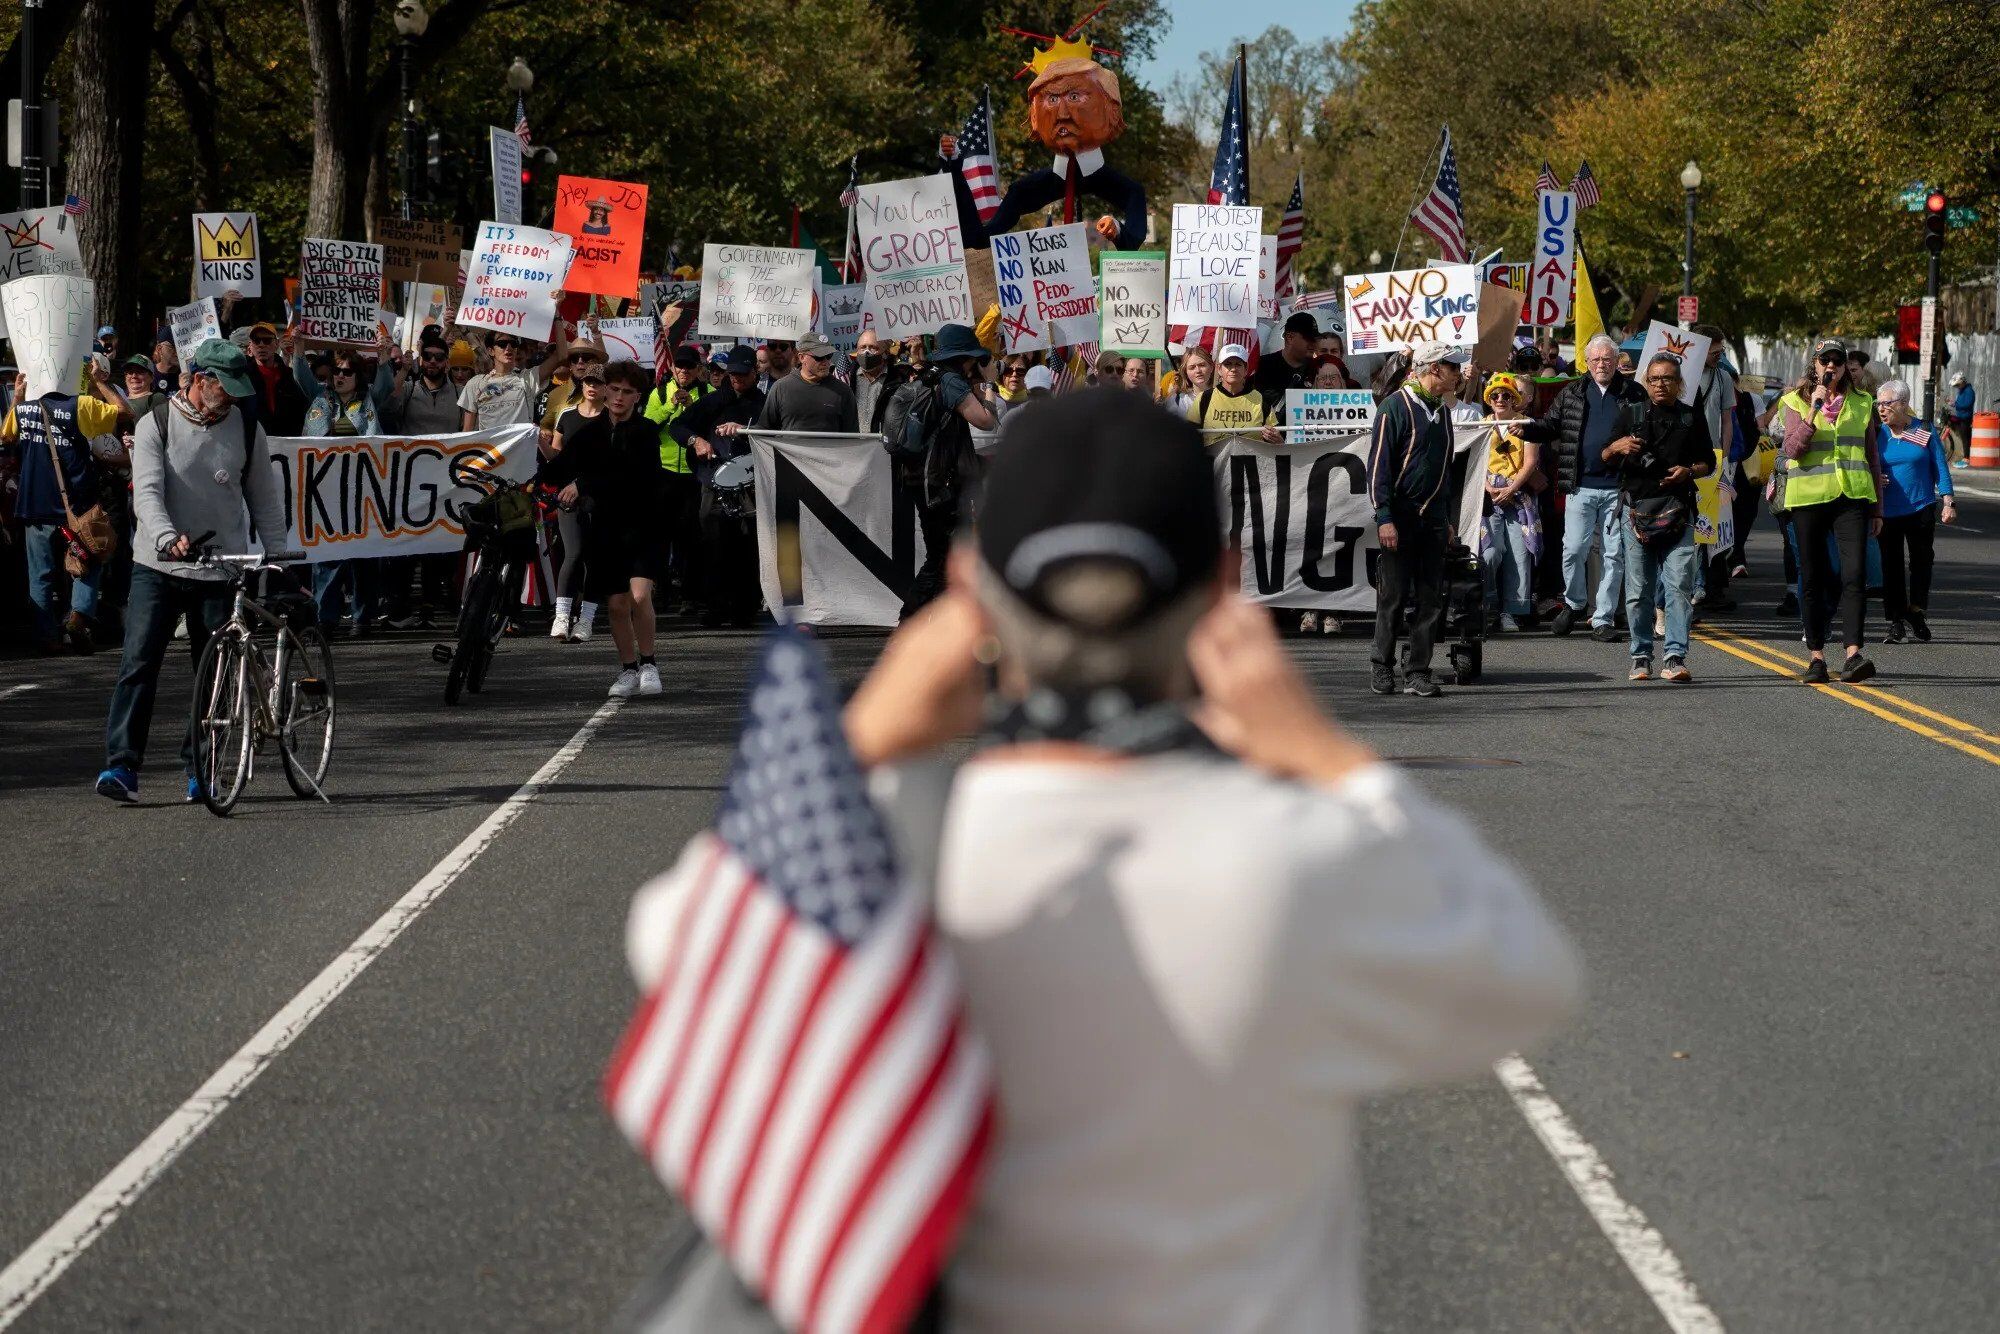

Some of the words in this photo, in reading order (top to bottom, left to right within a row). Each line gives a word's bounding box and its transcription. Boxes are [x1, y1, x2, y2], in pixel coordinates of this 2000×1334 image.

[559, 184, 589, 208] Hey
[610, 185, 643, 211] JD
[861, 195, 908, 227] You
[1173, 205, 1188, 230] I
[1198, 206, 1262, 228] PROTEST
[485, 226, 515, 240] IT'S
[217, 241, 241, 257] NO
[867, 226, 965, 272] GROPE
[995, 235, 1021, 258] NO
[1177, 231, 1257, 254] BECAUSE
[37, 252, 61, 264] THE
[414, 249, 438, 261] HIM
[445, 251, 460, 262] TO
[481, 254, 500, 264] FOR
[492, 244, 549, 260] FREEDOM
[574, 246, 621, 264] ACIST
[719, 247, 806, 268] GOVERNMENT
[41, 260, 80, 275] PEOPLE
[202, 262, 254, 281] KINGS
[487, 266, 553, 283] EVERYBODY
[718, 266, 737, 279] OF
[750, 266, 779, 280] THE
[999, 259, 1024, 281] NO
[1173, 259, 1190, 280] I
[1201, 257, 1251, 277] LOVE
[305, 274, 334, 289] HELL
[476, 275, 490, 286] OR
[874, 274, 964, 301] DEMOCRACY
[1389, 270, 1448, 298] NO
[2, 276, 93, 318] RESTORE
[304, 290, 338, 304] OVER
[349, 290, 380, 304] THEN
[473, 298, 490, 306] FOR
[481, 288, 528, 300] FREEDOM
[716, 294, 736, 307] FOR
[718, 281, 735, 294] BY
[744, 282, 802, 306] PEOPLE
[999, 284, 1023, 307] NO
[1105, 286, 1130, 301] NO
[1174, 284, 1251, 313] AMERICA
[323, 306, 347, 320] CUT
[349, 306, 375, 321] THE
[462, 307, 527, 328] NOBODY
[884, 293, 968, 329] DONALD!
[1114, 303, 1161, 319] KINGS
[16, 310, 82, 340] RULE
[713, 311, 743, 326] SHALL
[746, 312, 767, 324] NOT
[767, 313, 798, 330] PERISH
[833, 325, 859, 336] STOP
[29, 336, 62, 362] OF
[1304, 393, 1372, 405] IMPEACH
[53, 408, 71, 420] the
[1213, 410, 1252, 422] DEFEND
[1293, 408, 1369, 420] TRAITOR
[304, 448, 497, 538] KINGS
